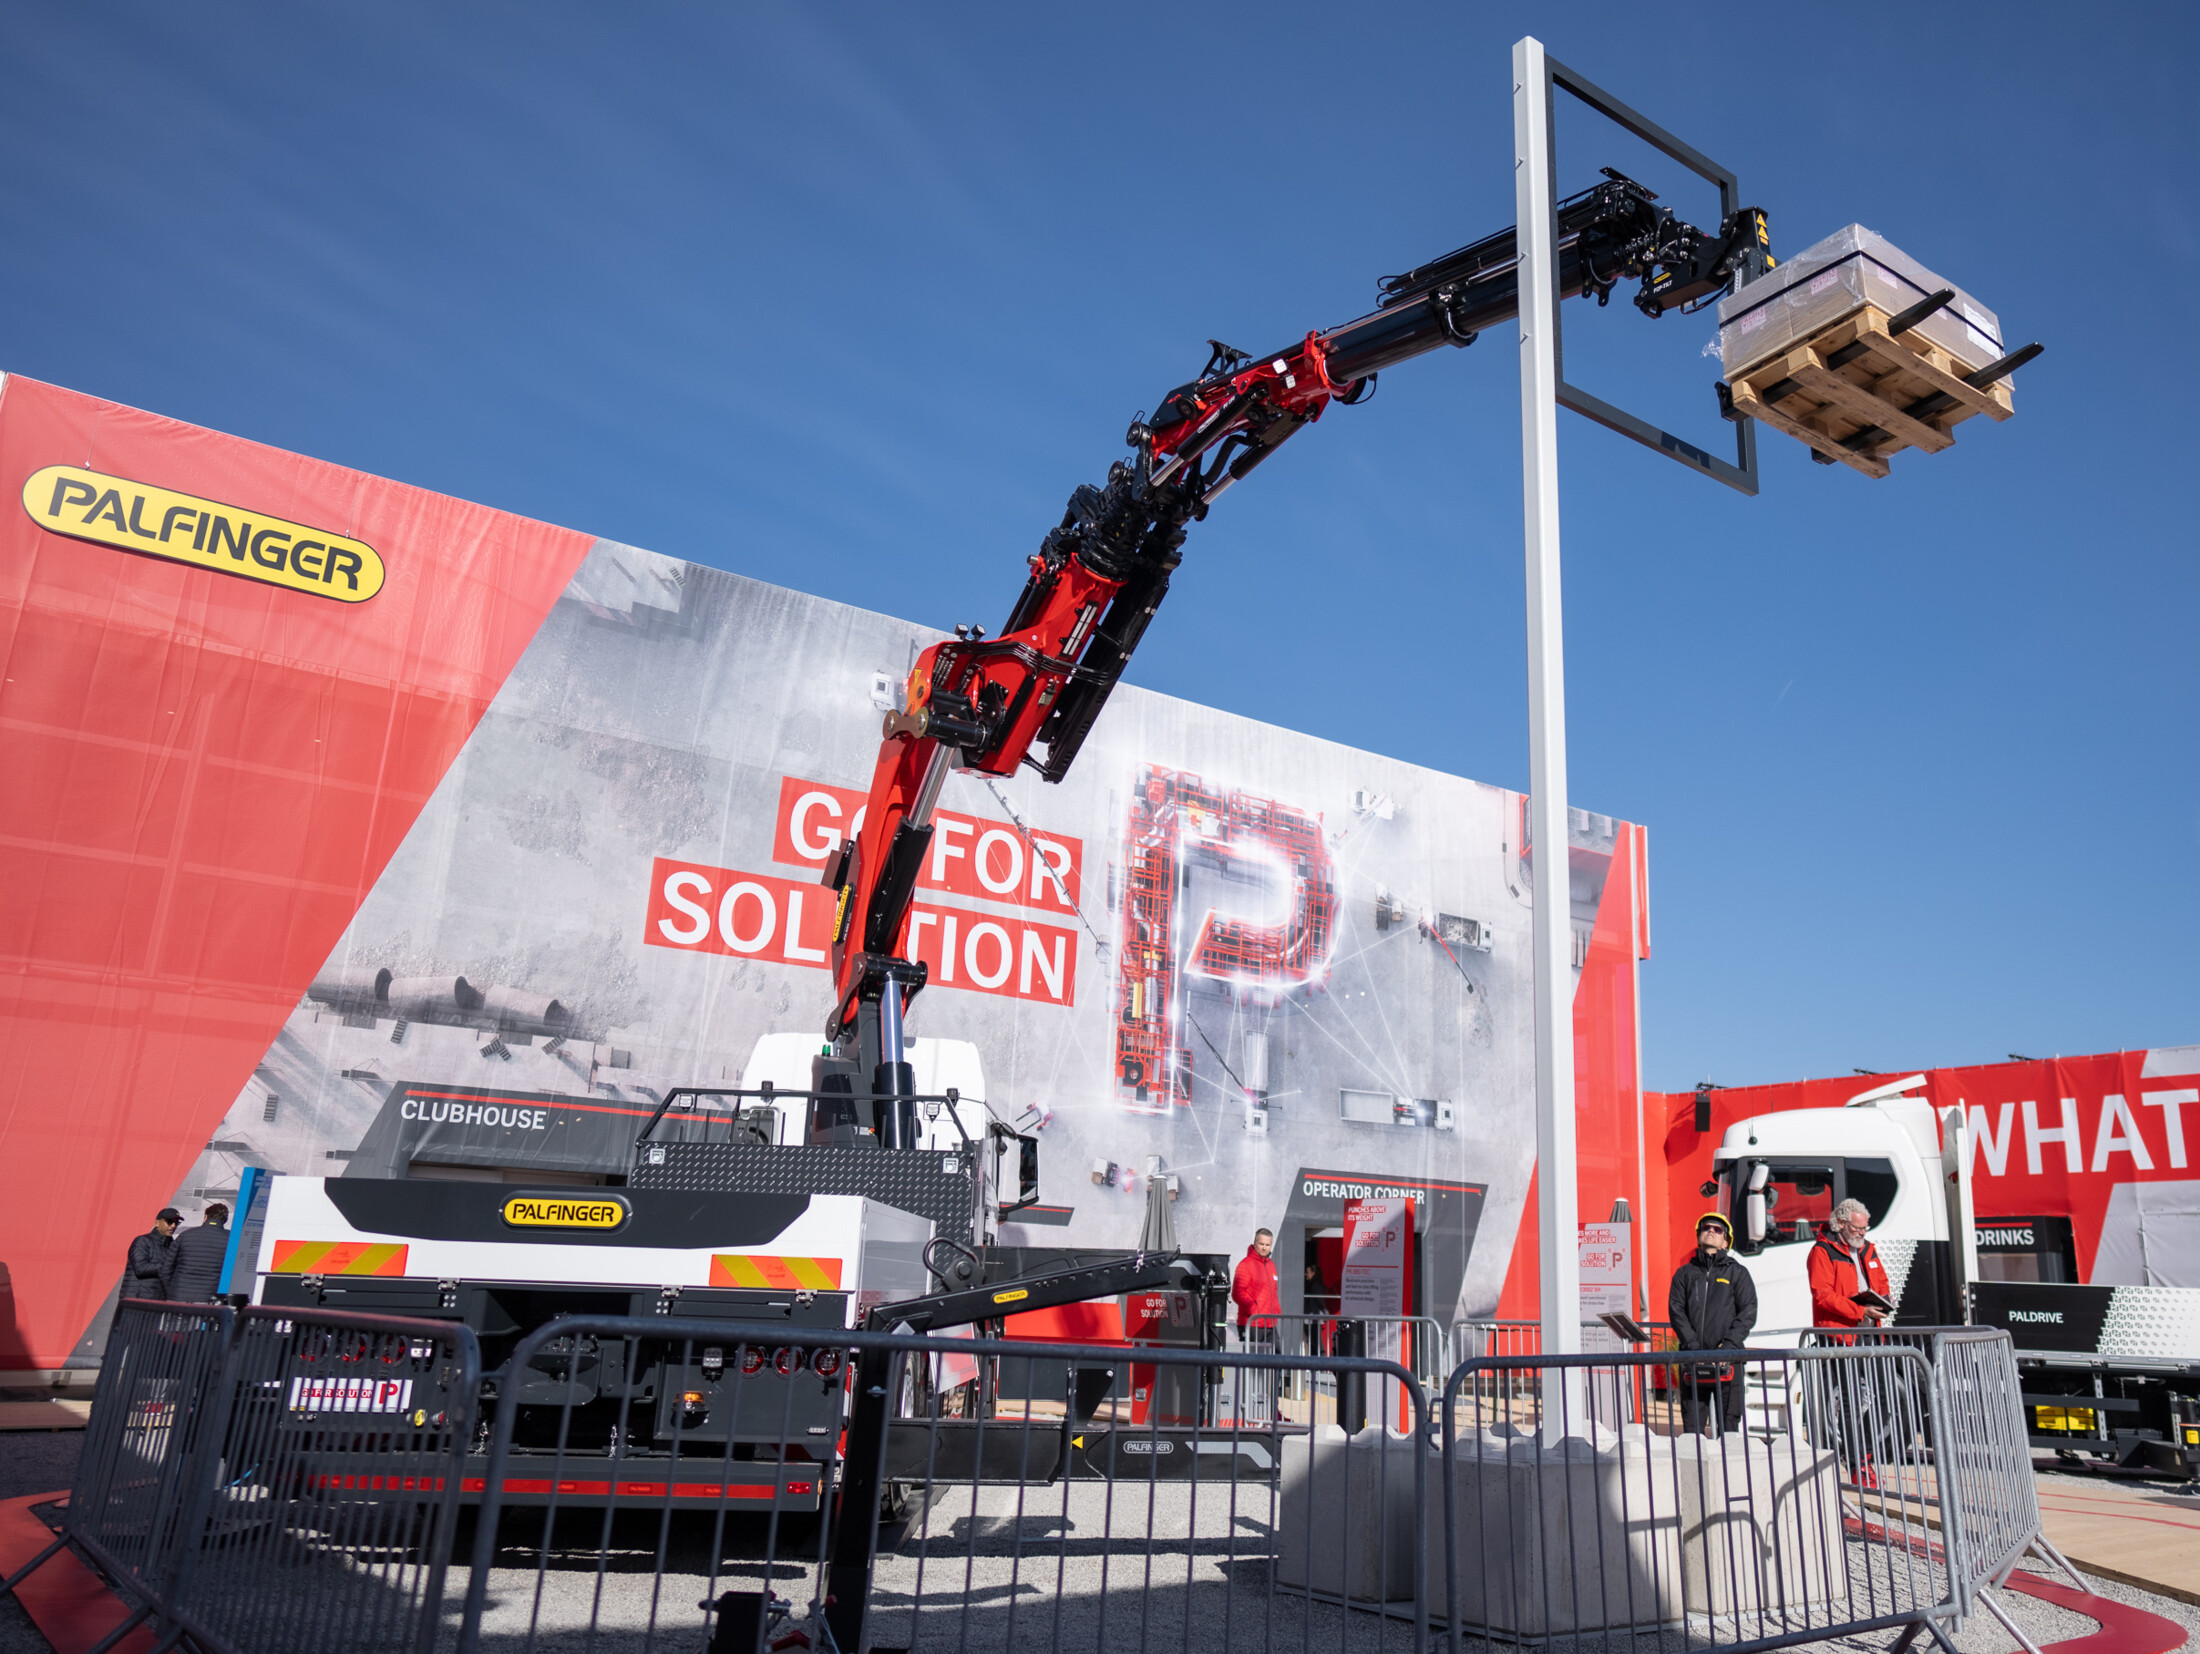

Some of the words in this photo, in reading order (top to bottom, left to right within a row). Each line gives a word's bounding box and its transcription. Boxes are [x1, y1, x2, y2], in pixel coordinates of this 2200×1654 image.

[48, 476, 363, 591] PALFINGER
[789, 791, 869, 860] G
[930, 816, 1073, 907] FOR
[656, 870, 1067, 1001] SOLTION
[401, 1099, 547, 1130] CLUBHOUSE
[1966, 1088, 2200, 1177] WHAT
[1302, 1181, 1372, 1199] OPERATOR
[1374, 1187, 1425, 1205] CORNER
[512, 1203, 615, 1222] PALFINGER
[1348, 1206, 1370, 1214] PUNCHES
[1974, 1229, 2035, 1246] DRINKS
[1140, 1308, 1169, 1318] SOLUTION
[1145, 1298, 1155, 1307] GO
[1155, 1299, 1168, 1308] FOR
[2008, 1310, 2064, 1324] PALDRIVE
